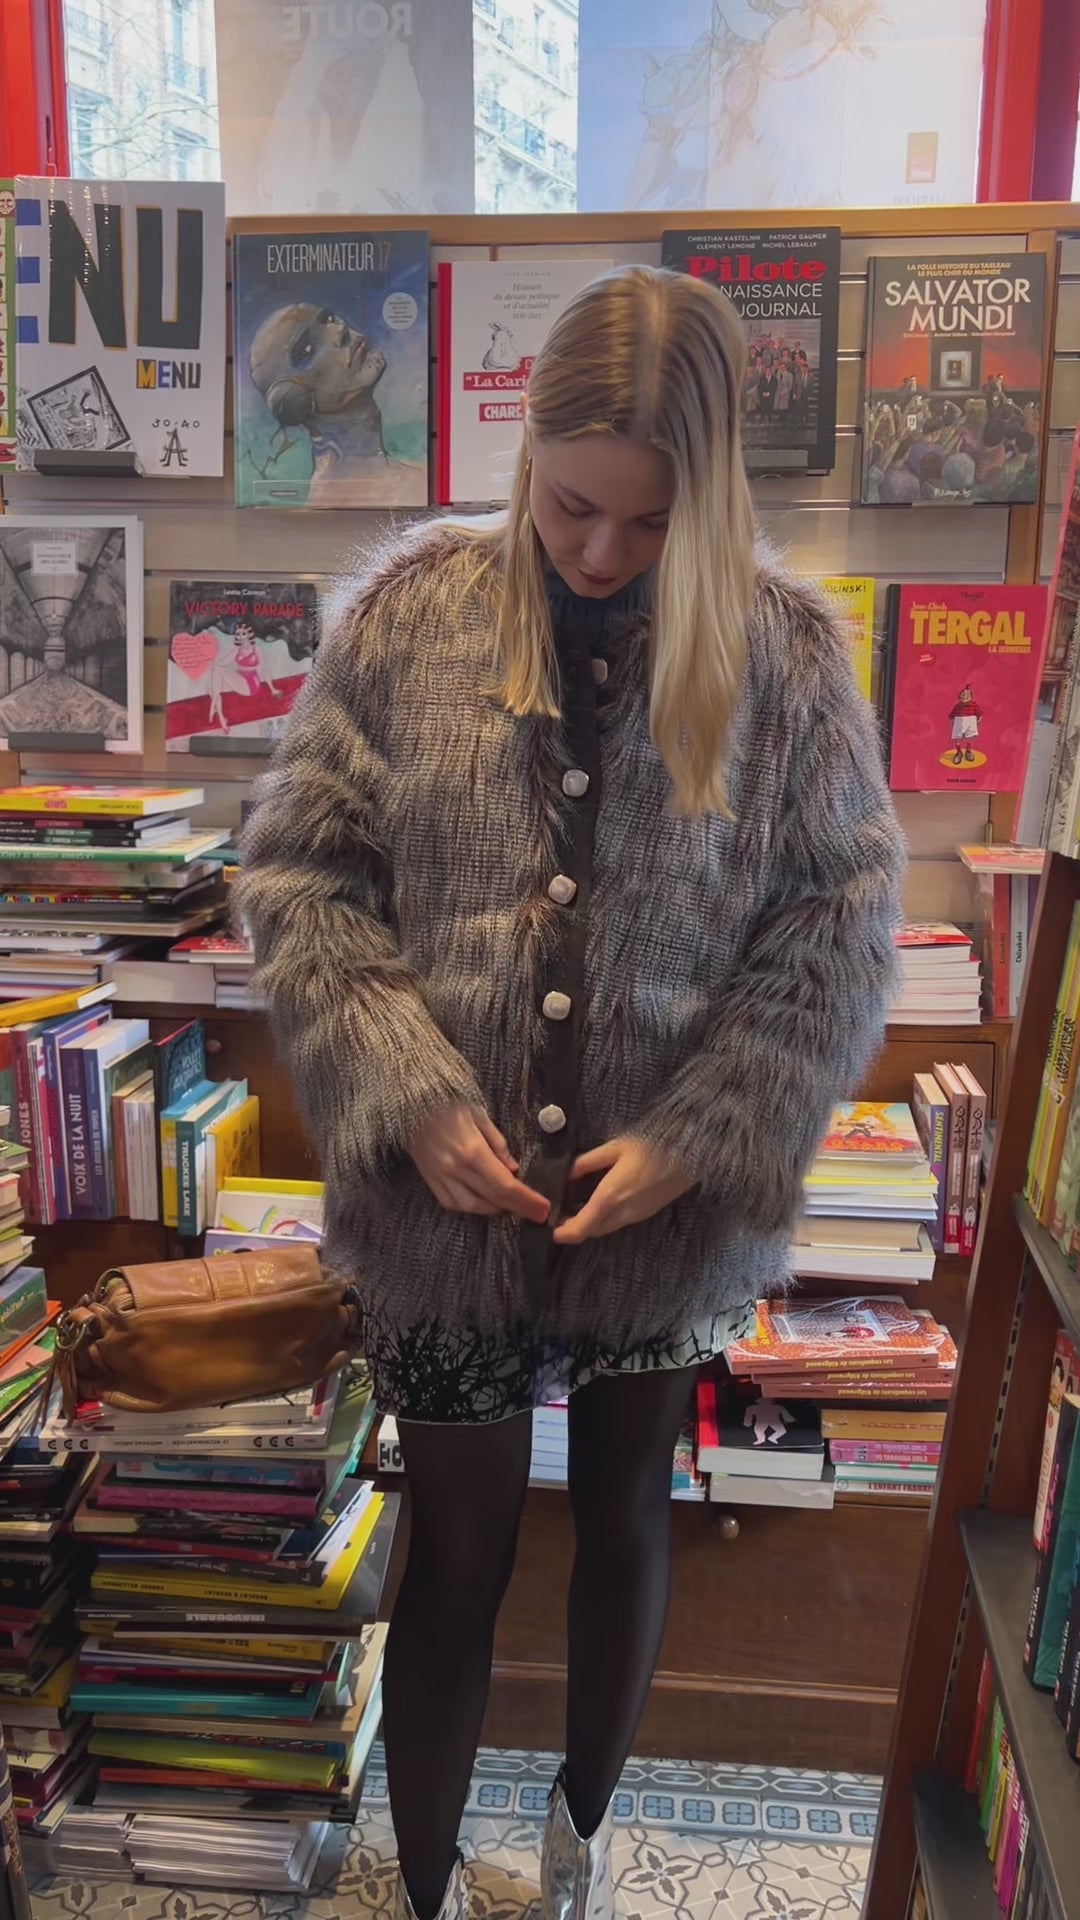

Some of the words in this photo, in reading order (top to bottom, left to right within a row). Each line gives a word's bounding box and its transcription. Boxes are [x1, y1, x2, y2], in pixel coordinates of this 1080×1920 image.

[687, 235, 723, 243] CHRISTIAN
[267, 242, 374, 273] EXTERMINATEUR
[685, 254, 827, 282] Pilote
[720, 283, 823, 298] NAISSANCE
[884, 278, 1031, 306] SALVATOR
[739, 302, 822, 318] JOURNAL
[909, 304, 1013, 331] MUNDI
[136, 359, 201, 389] MENU
[823, 580, 866, 593] OLINSKI
[184, 601, 248, 618] VICTORY
[253, 602, 304, 618] PARADE
[910, 610, 1031, 645] TERGAL
[68, 1093, 83, 1122] NUIT
[18, 1101, 31, 1145] JONES
[72, 1125, 84, 1141] LA
[933, 1111, 945, 1162] SENTIMENTAL
[73, 1143, 85, 1160] DE
[75, 1163, 87, 1195] VOIX
[182, 1189, 190, 1216] LAKE
